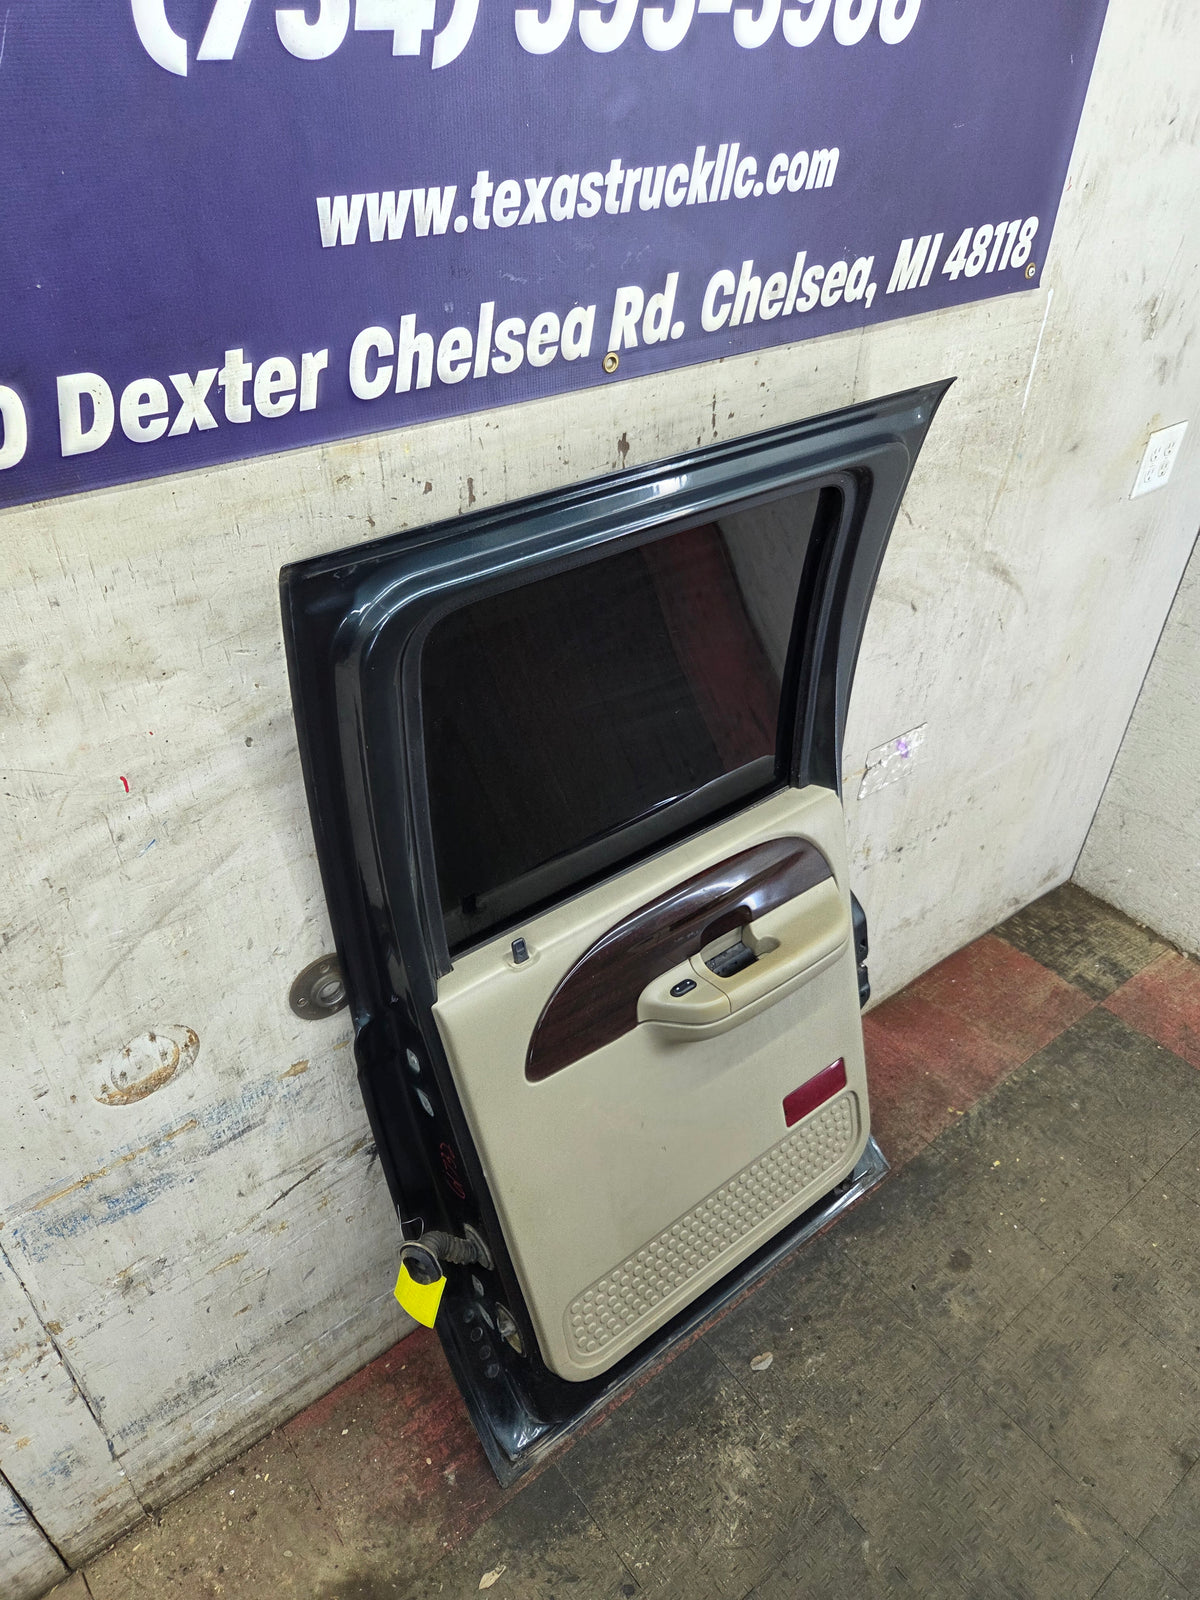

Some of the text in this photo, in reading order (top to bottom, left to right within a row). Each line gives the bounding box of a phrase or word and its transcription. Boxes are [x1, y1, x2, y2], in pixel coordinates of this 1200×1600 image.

[315, 142, 841, 248] www.texastruckllc.com
[56, 347, 329, 457] Dexter
[348, 300, 597, 400] Chelsea
[606, 270, 686, 353] Rd.
[700, 249, 878, 333] Chelsea,
[885, 232, 945, 295] MI
[941, 215, 1040, 281] 48118
